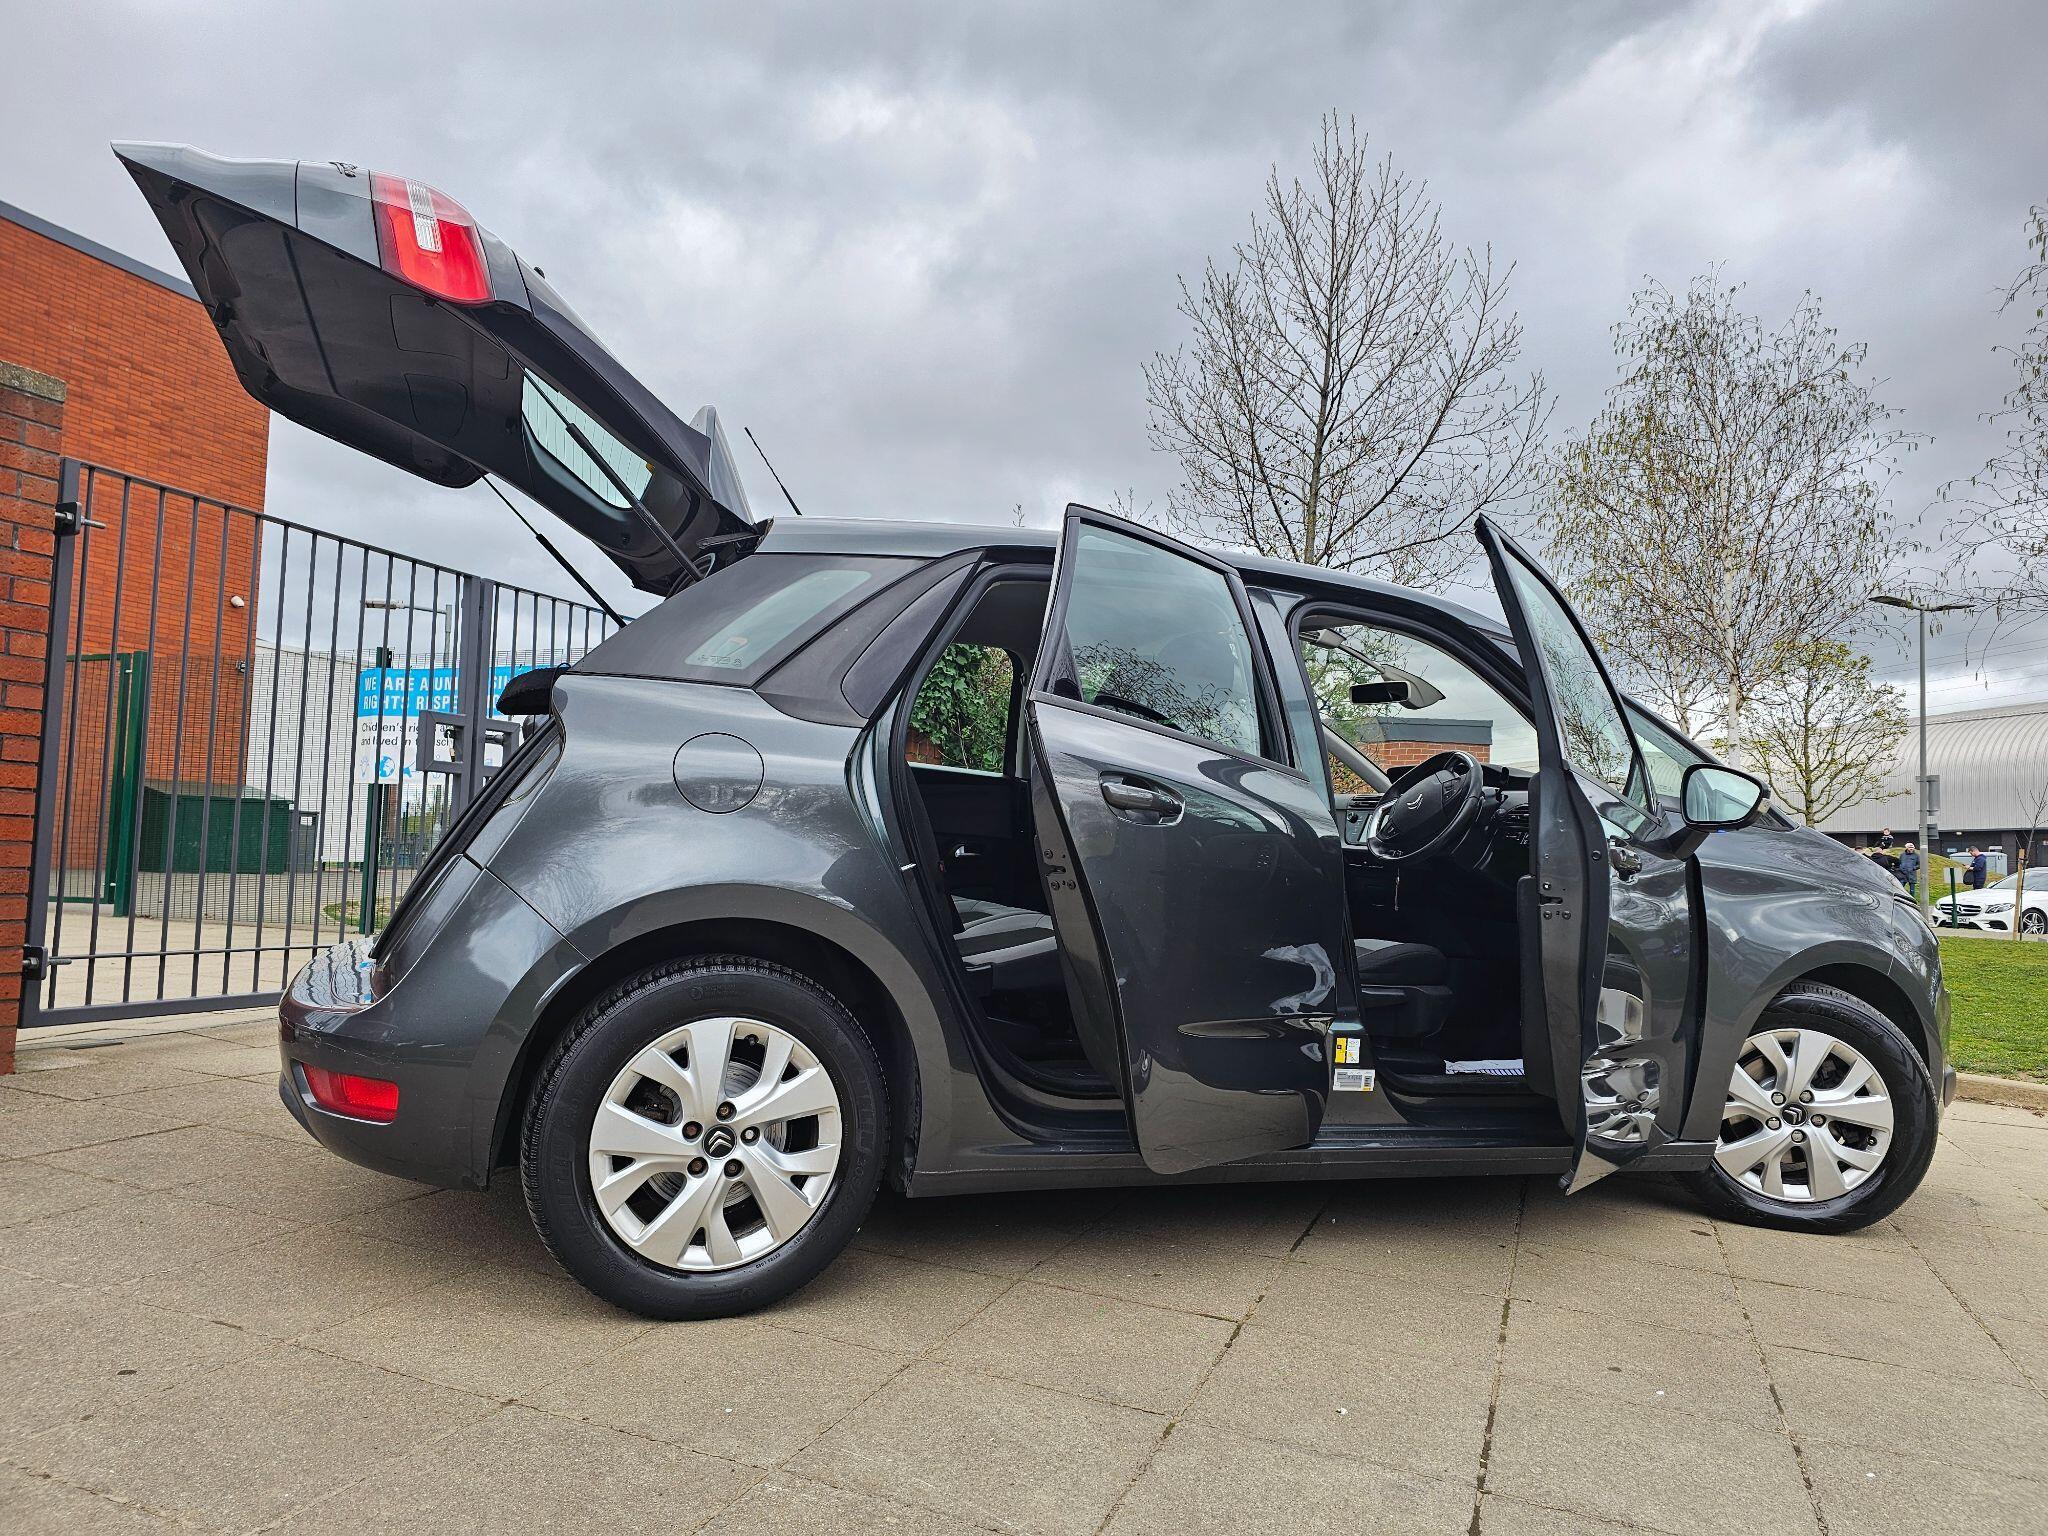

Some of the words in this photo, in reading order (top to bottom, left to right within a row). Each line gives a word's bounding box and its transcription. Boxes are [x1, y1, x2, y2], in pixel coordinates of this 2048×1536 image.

[365, 677, 377, 691] WE
[384, 677, 414, 691] ARE
[419, 677, 429, 691] A
